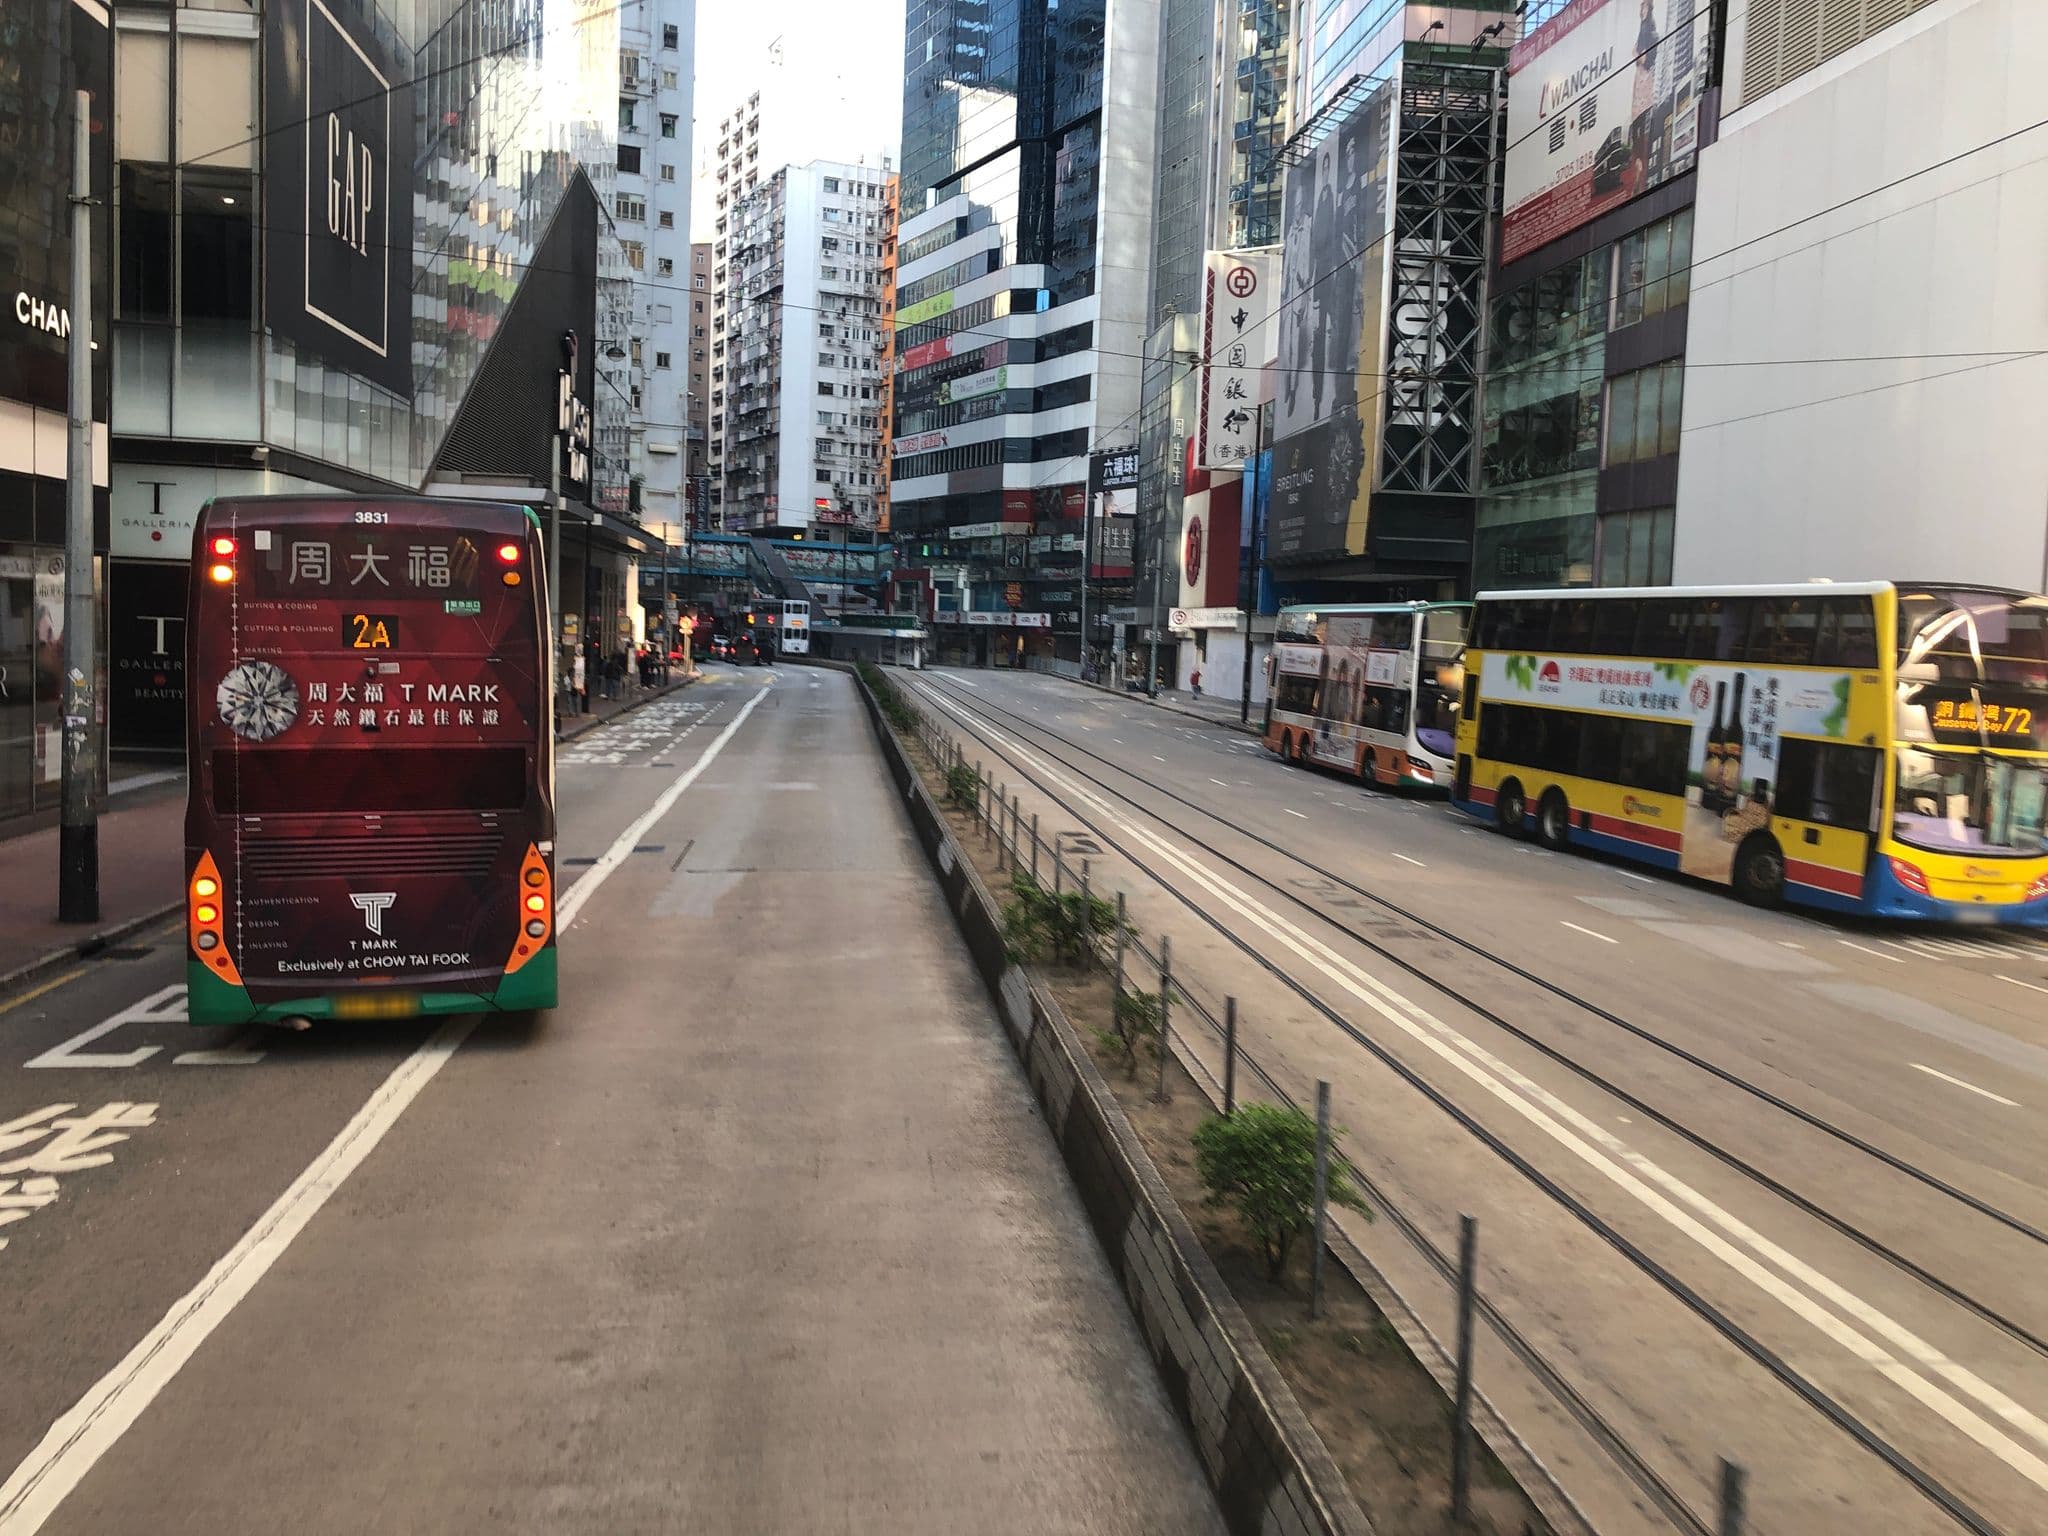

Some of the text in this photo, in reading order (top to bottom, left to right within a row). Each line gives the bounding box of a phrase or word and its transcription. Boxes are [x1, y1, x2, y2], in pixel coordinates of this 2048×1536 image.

[326, 111, 373, 258] GAP
[15, 291, 98, 350] CHANL
[1172, 417, 1185, 487] 周生生
[1275, 469, 1315, 492] BREITLING
[137, 480, 177, 514] T
[121, 518, 192, 529] GALLERIA
[355, 511, 389, 524] 3831
[288, 541, 452, 588] 周大福
[244, 601, 274, 610] BUYING
[285, 602, 318, 611] CODING
[244, 624, 278, 633] CUTTING
[292, 625, 334, 633] POLISHING
[353, 614, 391, 649] 2A
[245, 647, 282, 655] MARKING
[120, 659, 184, 671] GALLER
[134, 687, 185, 700] BEAUTY
[307, 682, 499, 703] 周大福 T MARK
[307, 708, 500, 727] 天然鑽石最佳保證
[2003, 707, 2032, 734] 72
[1983, 719, 2003, 733] Bay
[248, 896, 320, 905] AUTHENTICATION
[248, 919, 280, 928] DESIGN
[350, 939, 398, 950] T MARK
[278, 952, 470, 972] Exclusively at CHOW TAI FOOK
